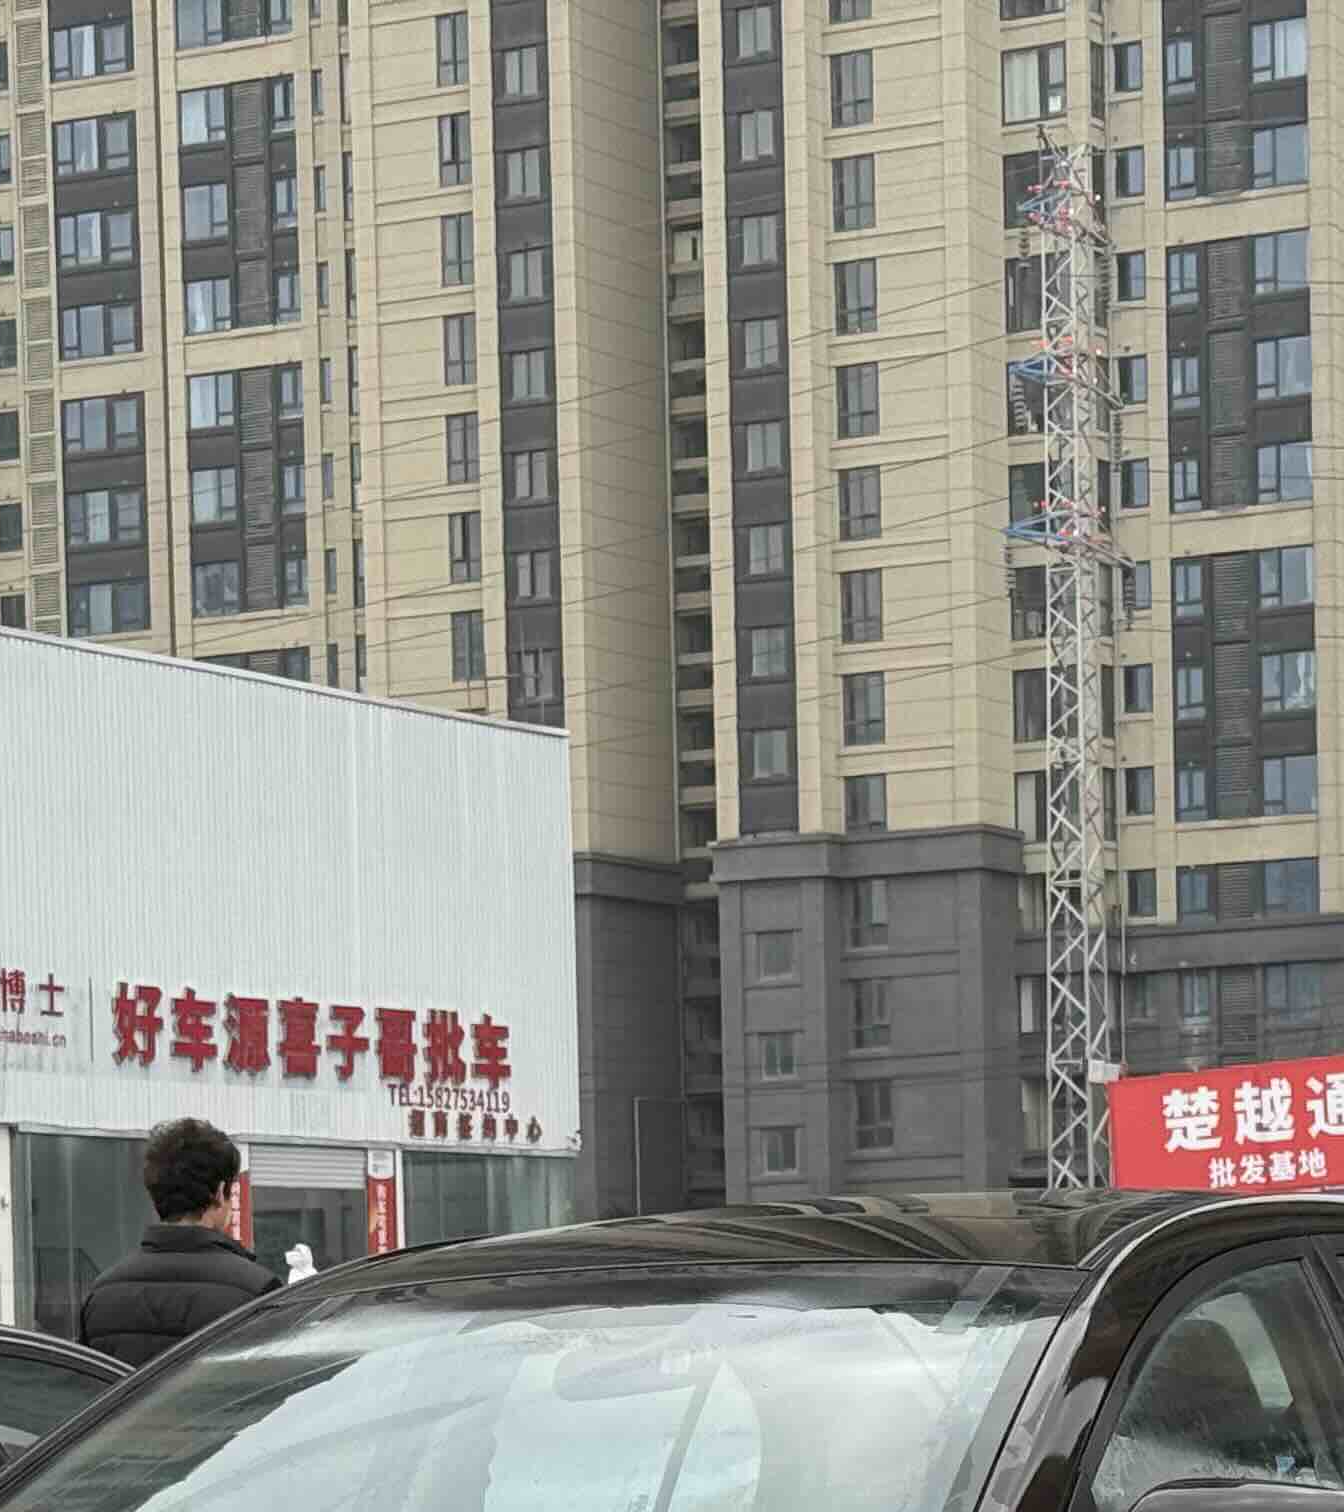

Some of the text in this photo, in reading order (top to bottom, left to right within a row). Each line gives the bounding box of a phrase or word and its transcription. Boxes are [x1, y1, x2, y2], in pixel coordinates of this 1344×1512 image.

[112, 982, 512, 1087] 好车源喜子哥批车
[1208, 1147, 1329, 1189] 批发基地
